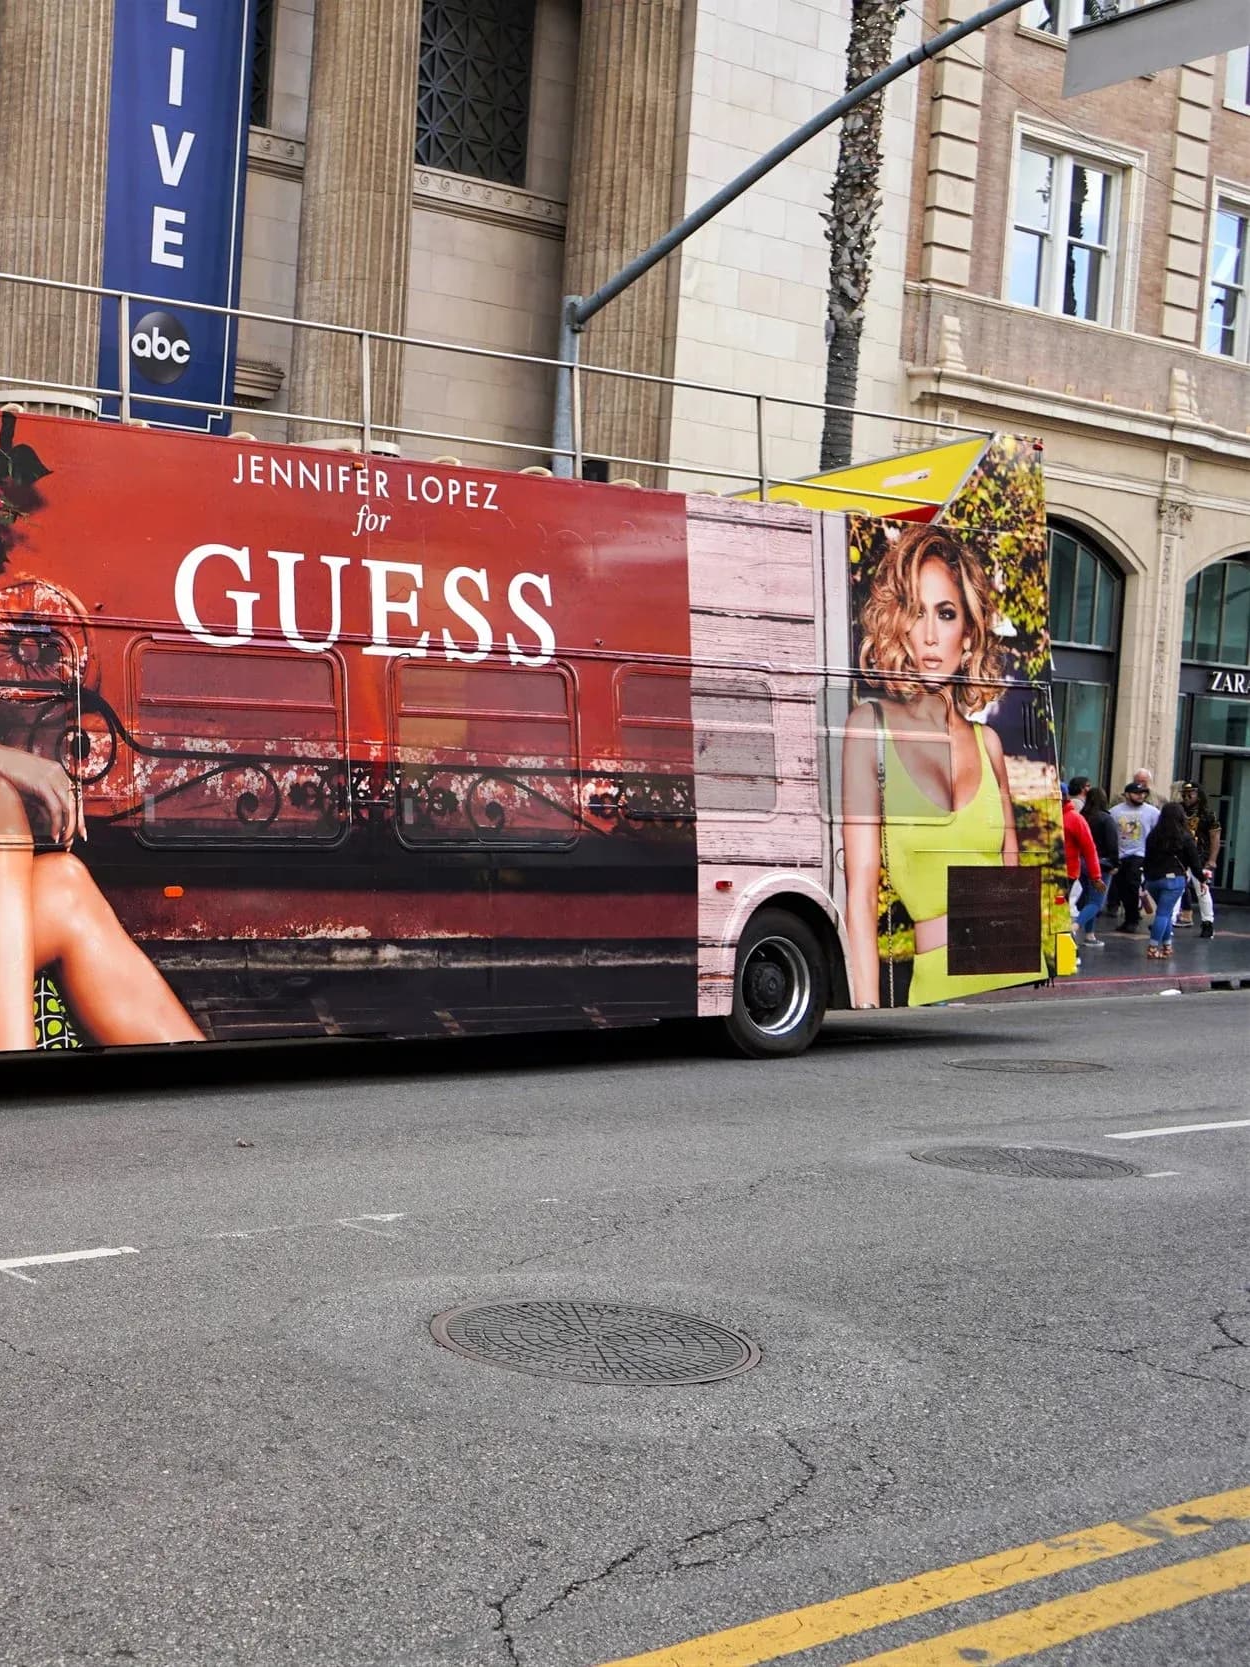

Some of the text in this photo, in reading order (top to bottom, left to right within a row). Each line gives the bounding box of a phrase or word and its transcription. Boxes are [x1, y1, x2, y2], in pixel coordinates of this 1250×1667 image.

[131, 326, 191, 364] abc
[232, 453, 499, 510] JENNIFER LOPEZ
[352, 503, 391, 537] for
[174, 543, 557, 667] GUESS
